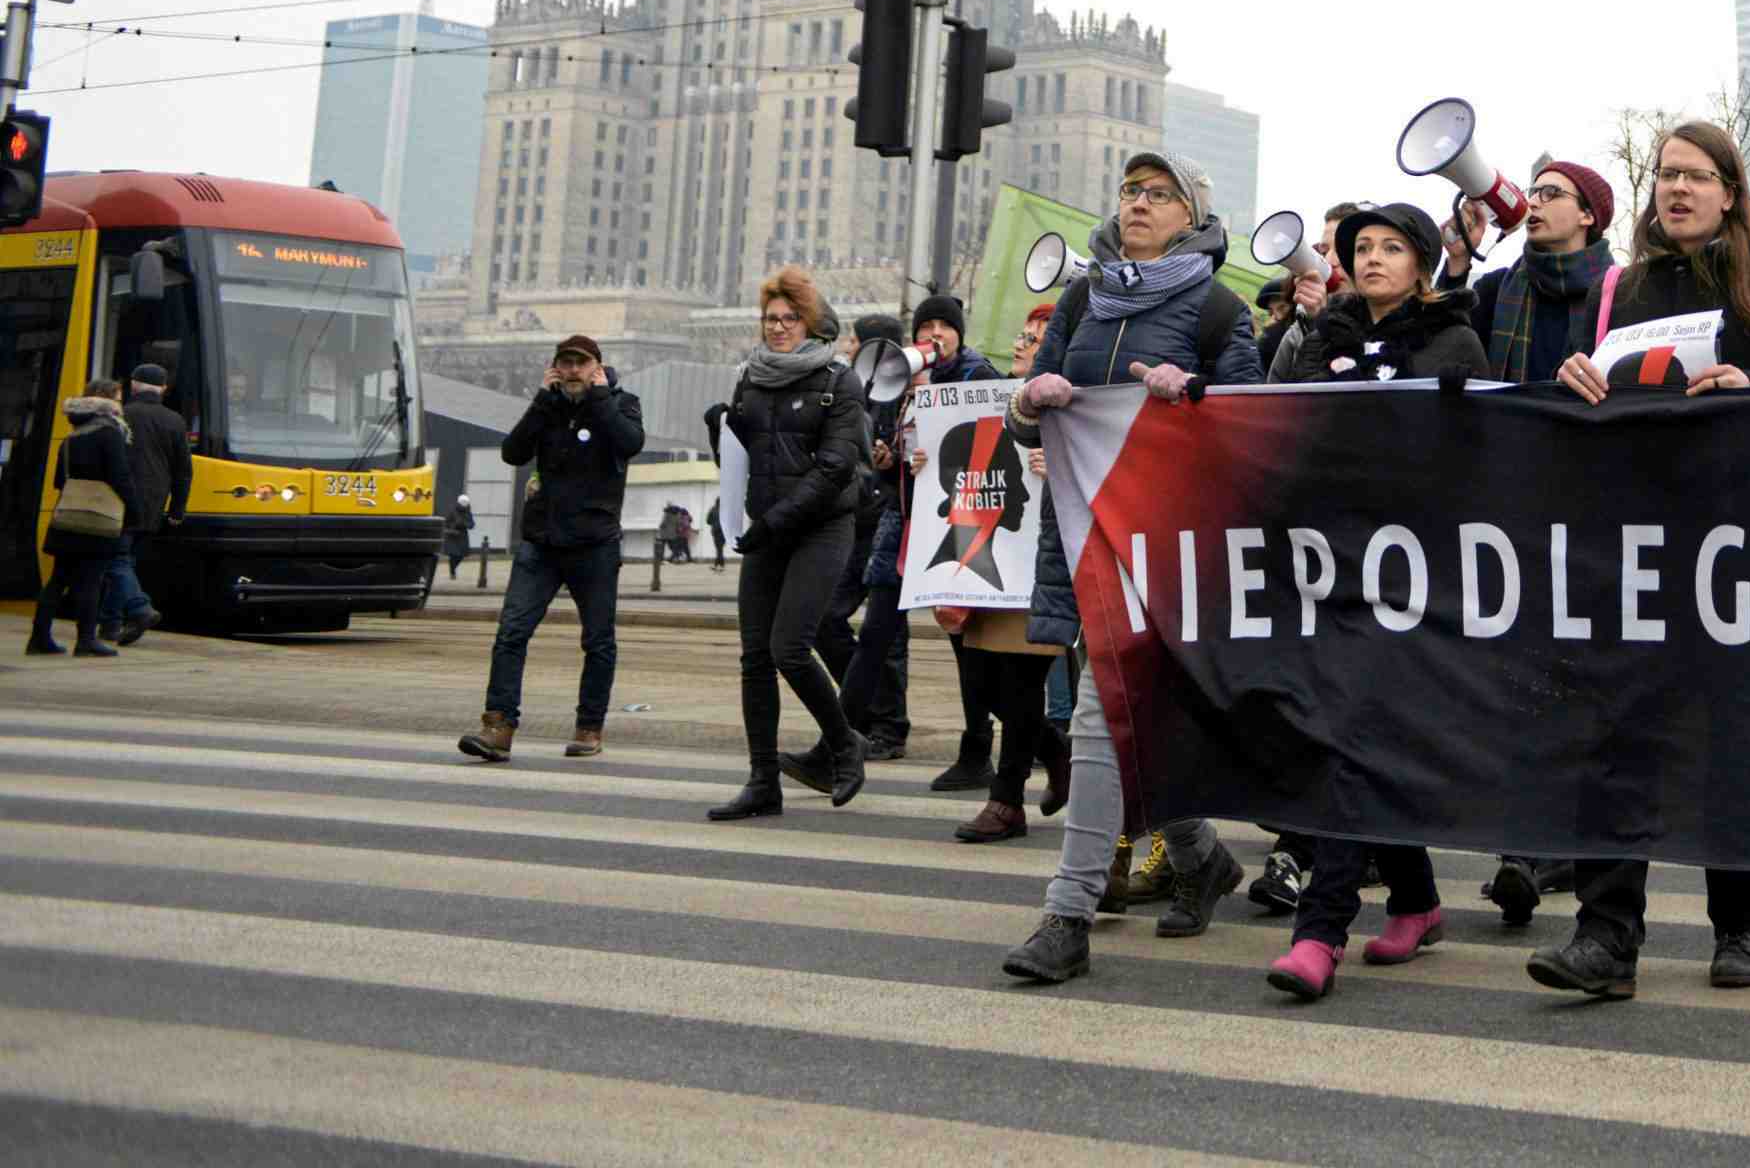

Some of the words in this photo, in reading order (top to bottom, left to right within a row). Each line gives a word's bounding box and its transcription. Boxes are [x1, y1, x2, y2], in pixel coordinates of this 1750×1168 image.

[917, 387, 959, 409] 23/03
[964, 389, 989, 405] 16:00
[325, 475, 377, 496] 3244
[955, 470, 1008, 489] STRAJK
[954, 491, 1007, 511] KOBIET
